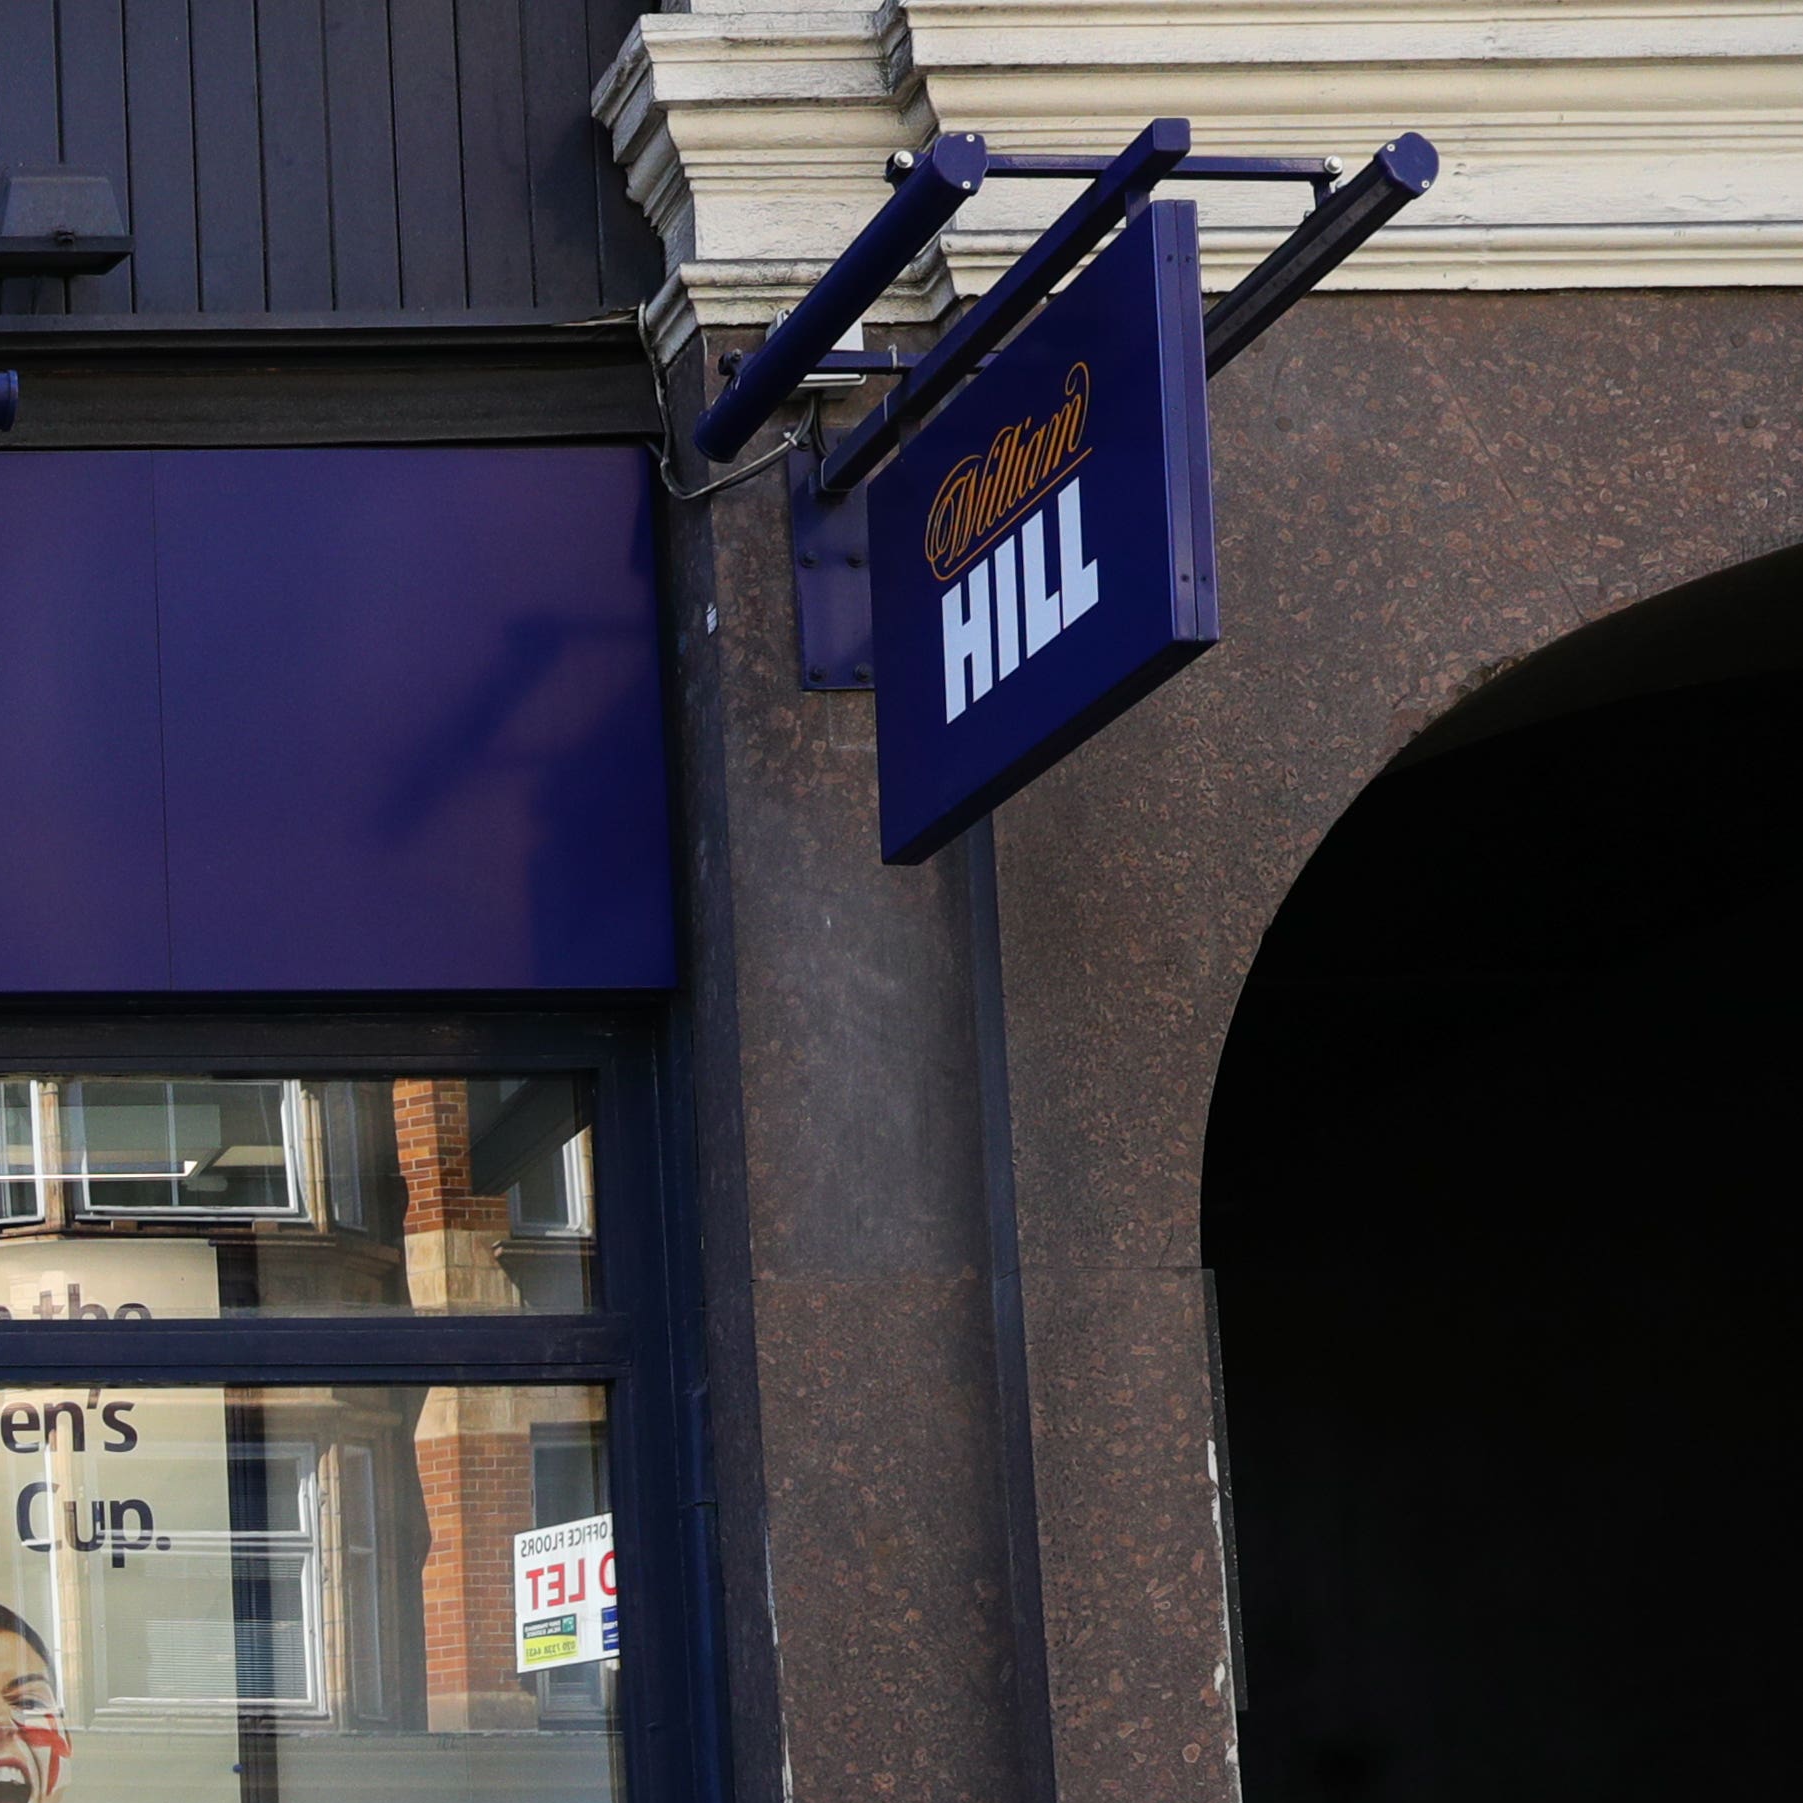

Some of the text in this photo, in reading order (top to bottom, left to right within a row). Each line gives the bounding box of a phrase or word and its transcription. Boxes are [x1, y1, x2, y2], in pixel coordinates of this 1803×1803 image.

[925, 361, 1090, 581] William
[941, 476, 1099, 725] HILL
[16, 1481, 172, 1569] Cup.
